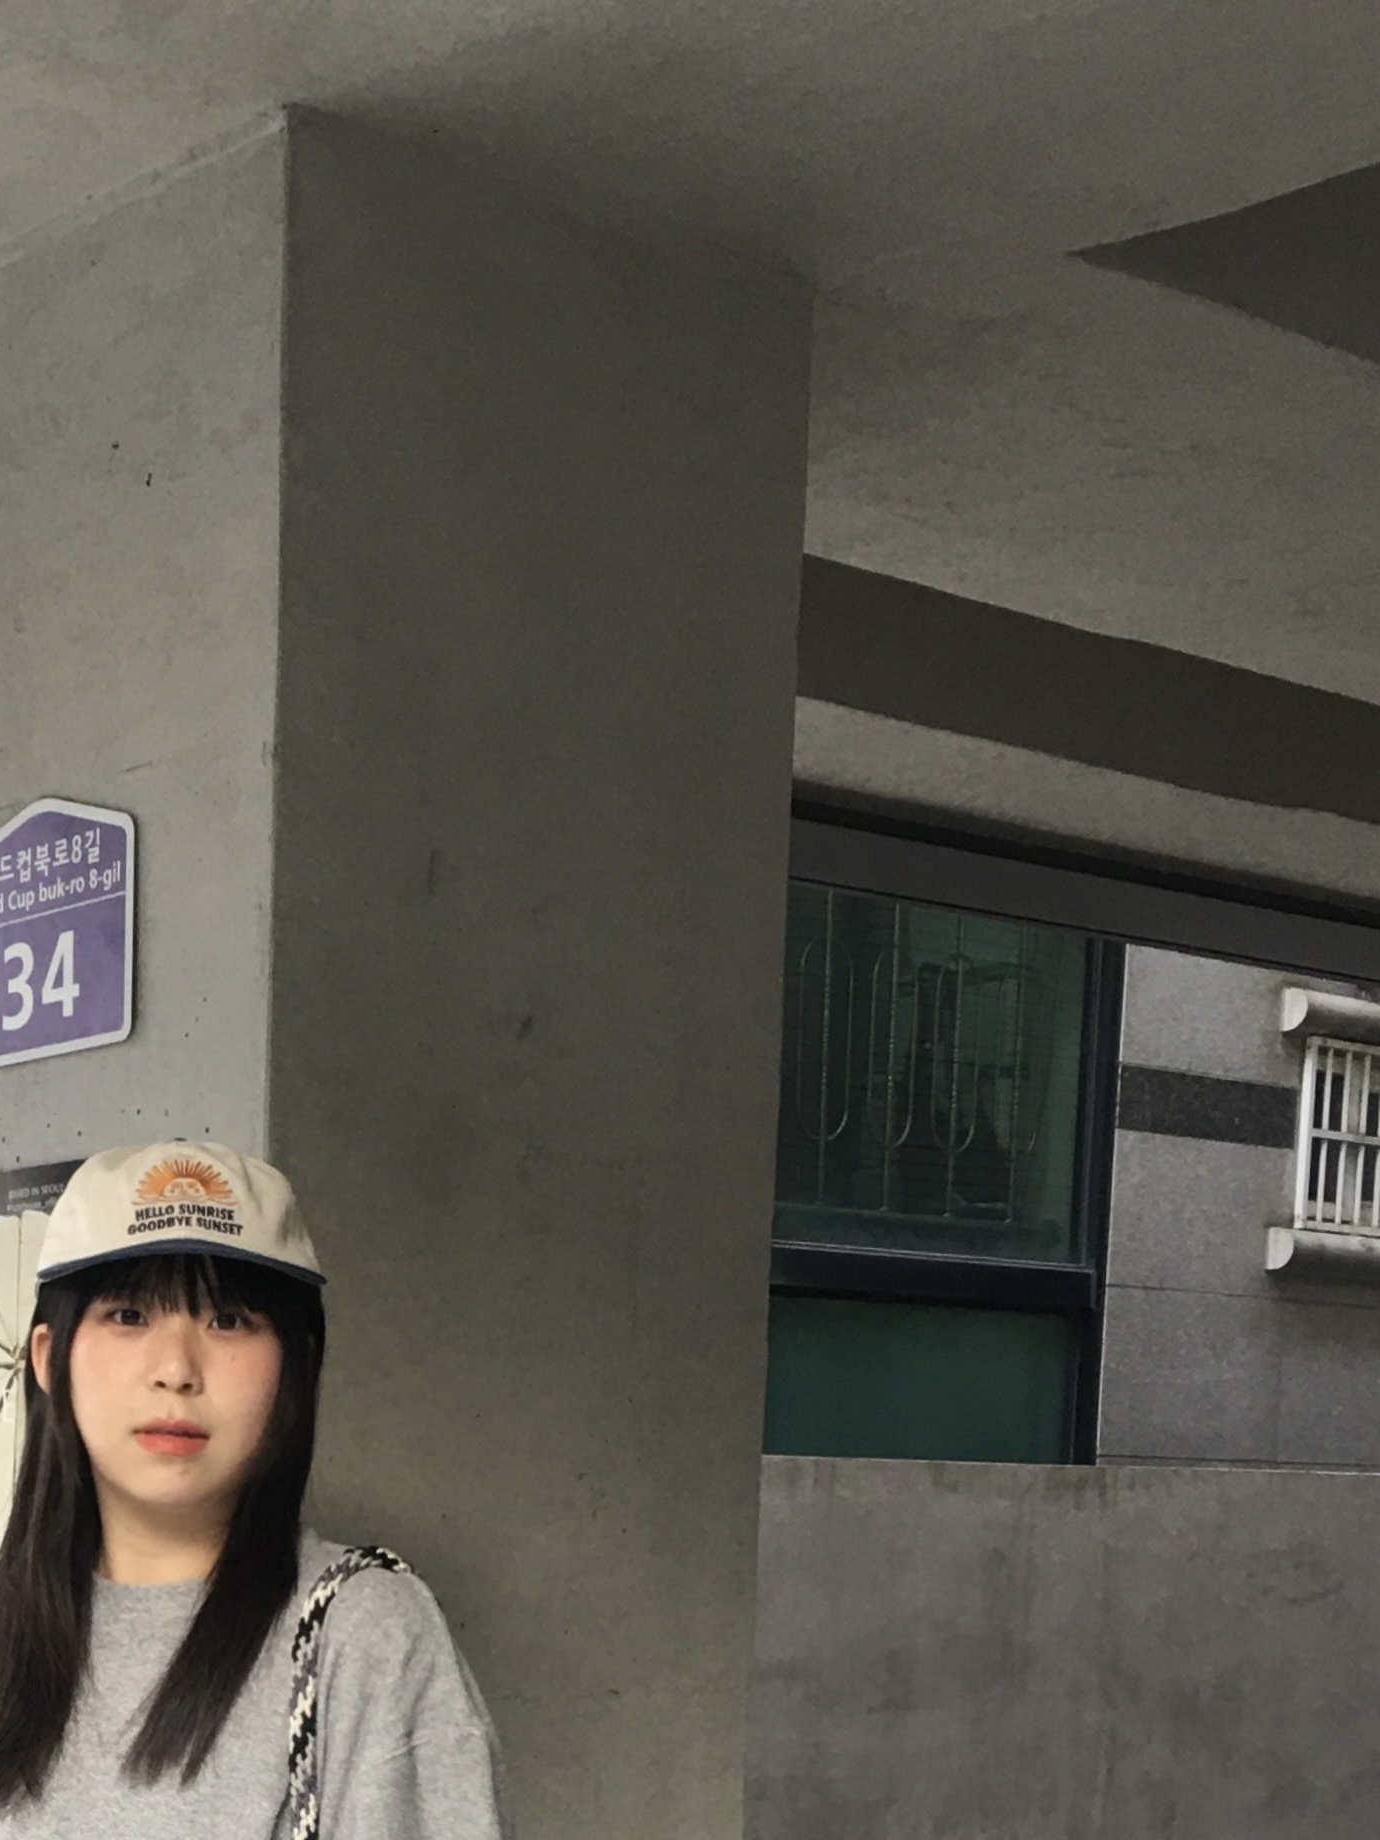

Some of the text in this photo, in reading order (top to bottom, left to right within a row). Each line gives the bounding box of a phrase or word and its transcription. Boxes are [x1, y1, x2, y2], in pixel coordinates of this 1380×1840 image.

[8, 889, 35, 911] Cup
[38, 876, 85, 902] buk-ro
[89, 860, 121, 891] 8-gil
[2, 930, 80, 1031] 34
[127, 1216, 243, 1236] GOODBYE SUNSET
[135, 1204, 235, 1221] HELLO SUNRISE
